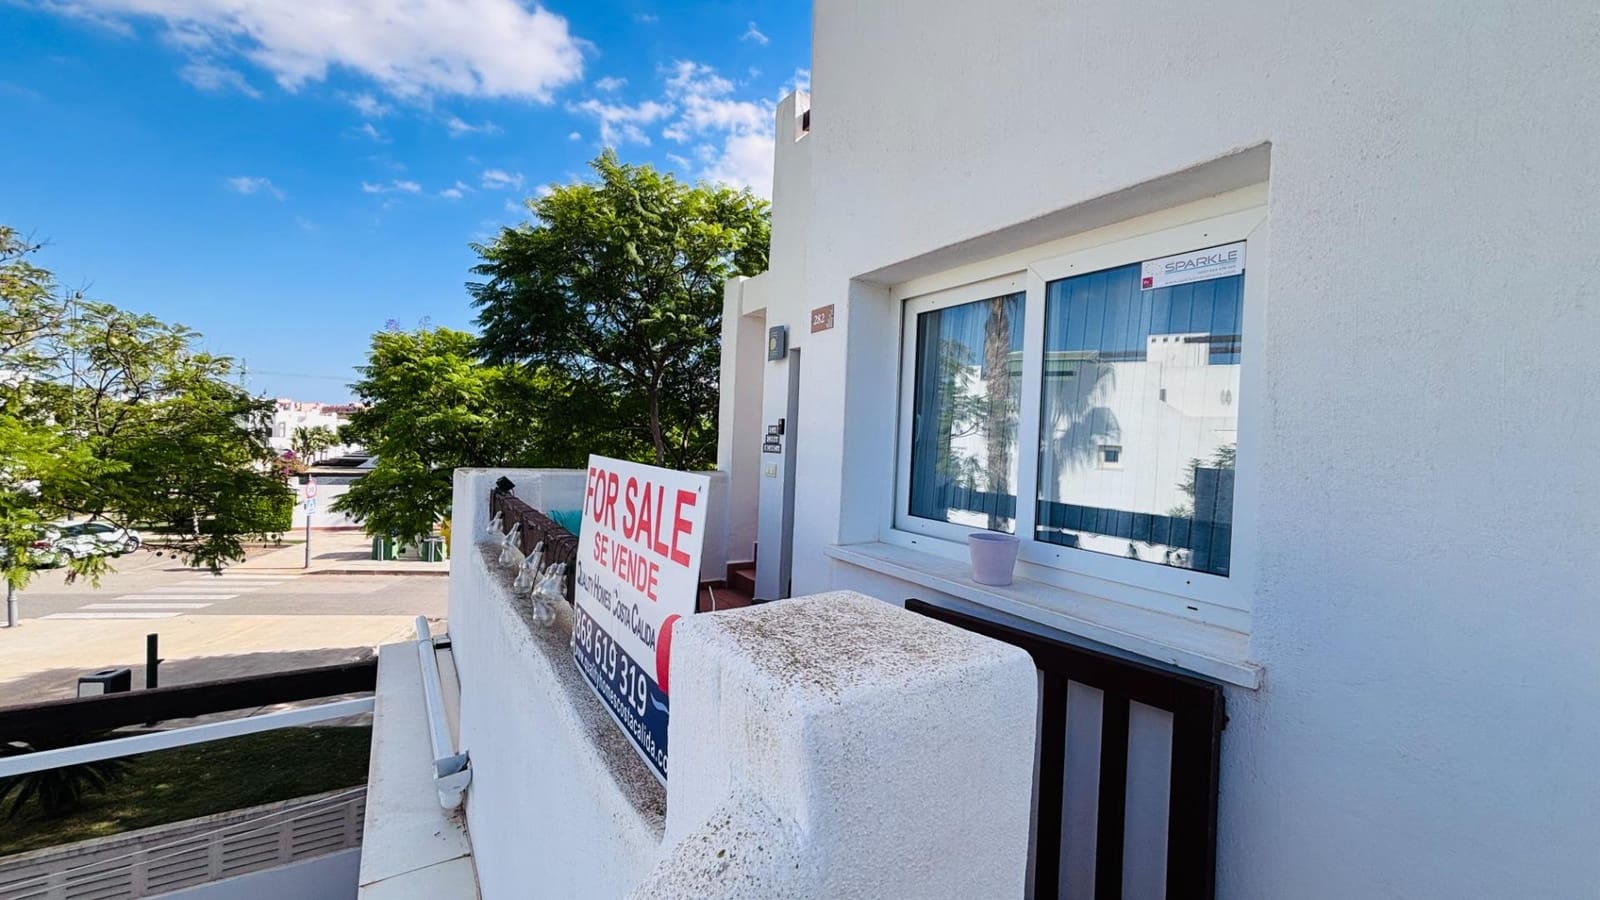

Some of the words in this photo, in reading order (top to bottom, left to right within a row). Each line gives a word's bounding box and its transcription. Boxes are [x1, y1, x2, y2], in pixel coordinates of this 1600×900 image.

[1165, 250, 1238, 273] SPARKLE
[585, 466, 619, 531] FOR
[622, 476, 697, 569] SALE
[593, 531, 608, 567] SE
[611, 540, 660, 602] VENDE
[612, 587, 631, 631] COSTA
[631, 603, 656, 652] CALIDA
[575, 607, 593, 654] 868
[594, 629, 618, 681] 619
[619, 654, 647, 717] 319
